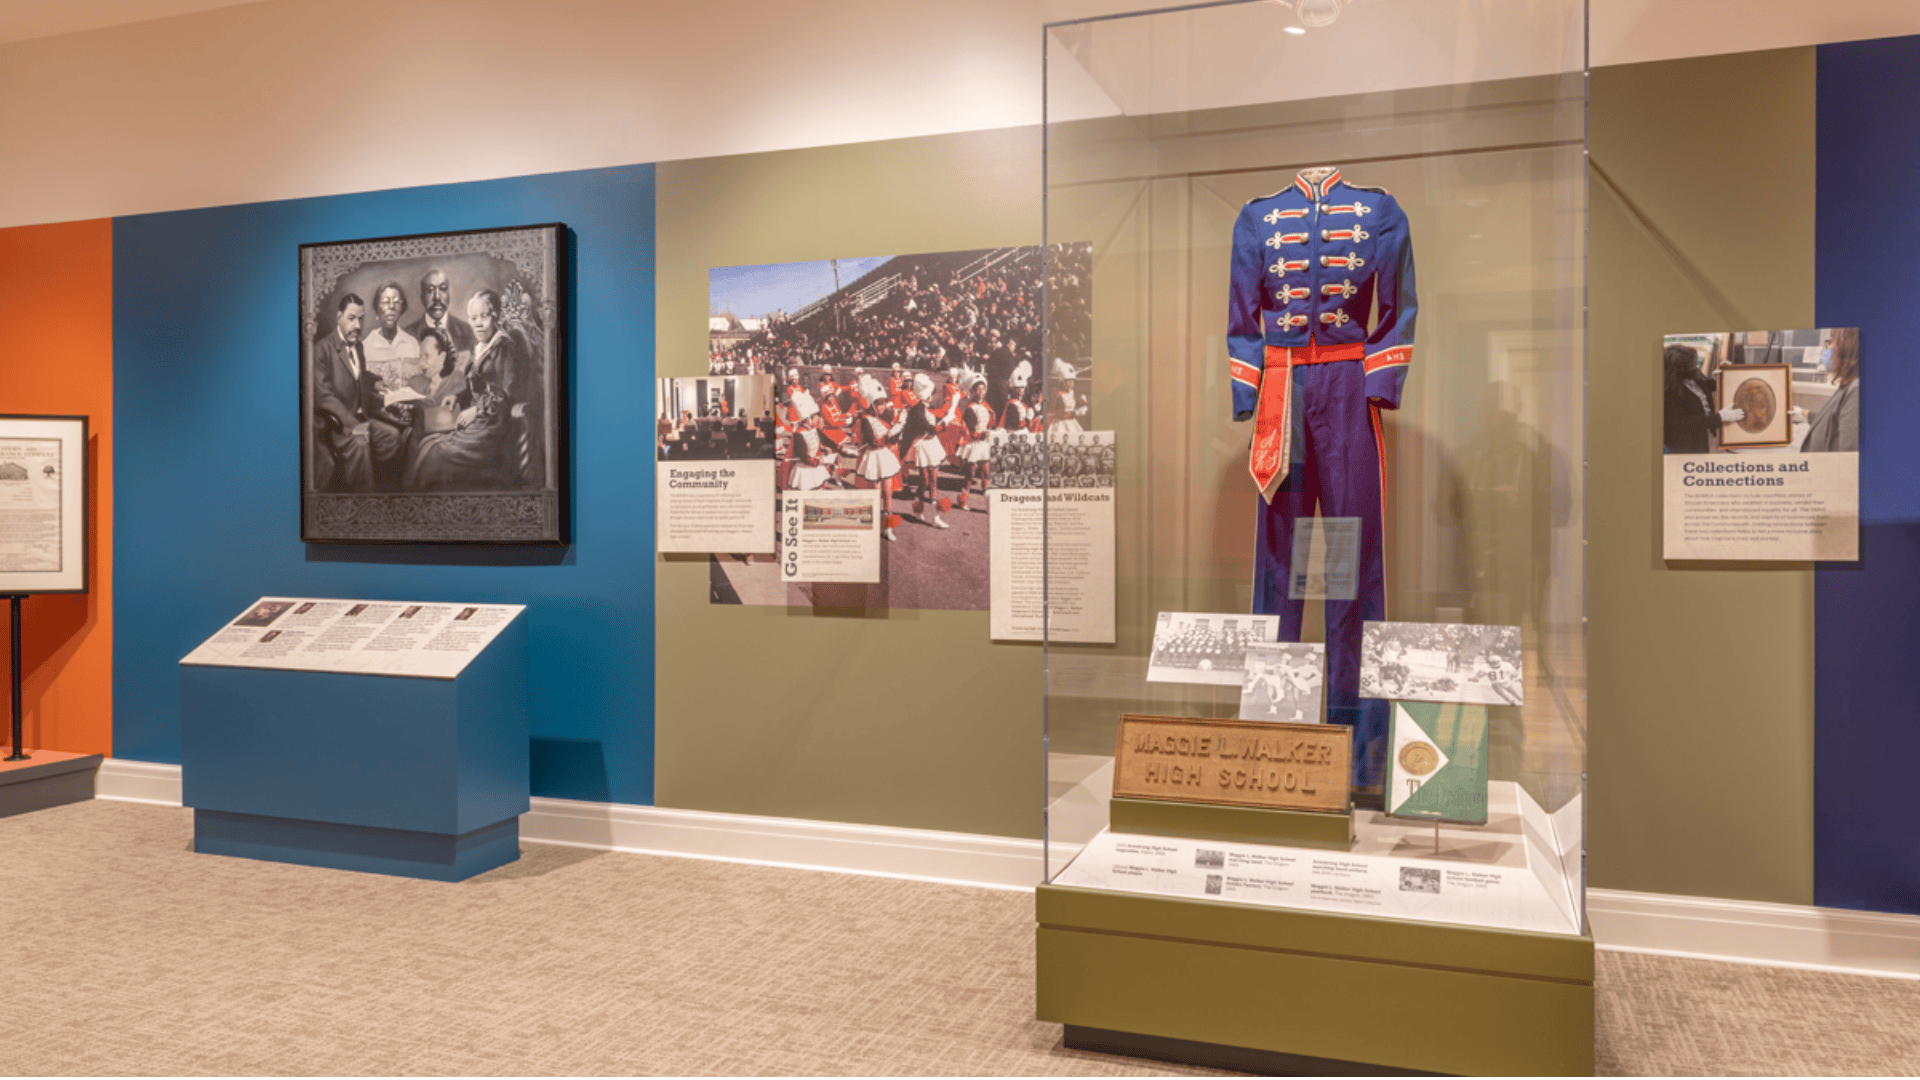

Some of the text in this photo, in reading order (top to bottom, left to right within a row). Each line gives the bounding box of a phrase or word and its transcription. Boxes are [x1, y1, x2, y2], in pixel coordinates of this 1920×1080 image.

[1683, 460, 1810, 473] Collections and
[669, 468, 736, 480] Engaging the
[669, 479, 729, 491] Community
[1683, 475, 1784, 487] Connections
[1000, 493, 1043, 504] Dragons
[1064, 493, 1111, 502] Wildcats
[784, 498, 799, 578] Go See It
[1488, 670, 1504, 681] 81
[1134, 733, 1211, 758] MAGGIE
[1145, 762, 1317, 796] HIGH SCHOOL
